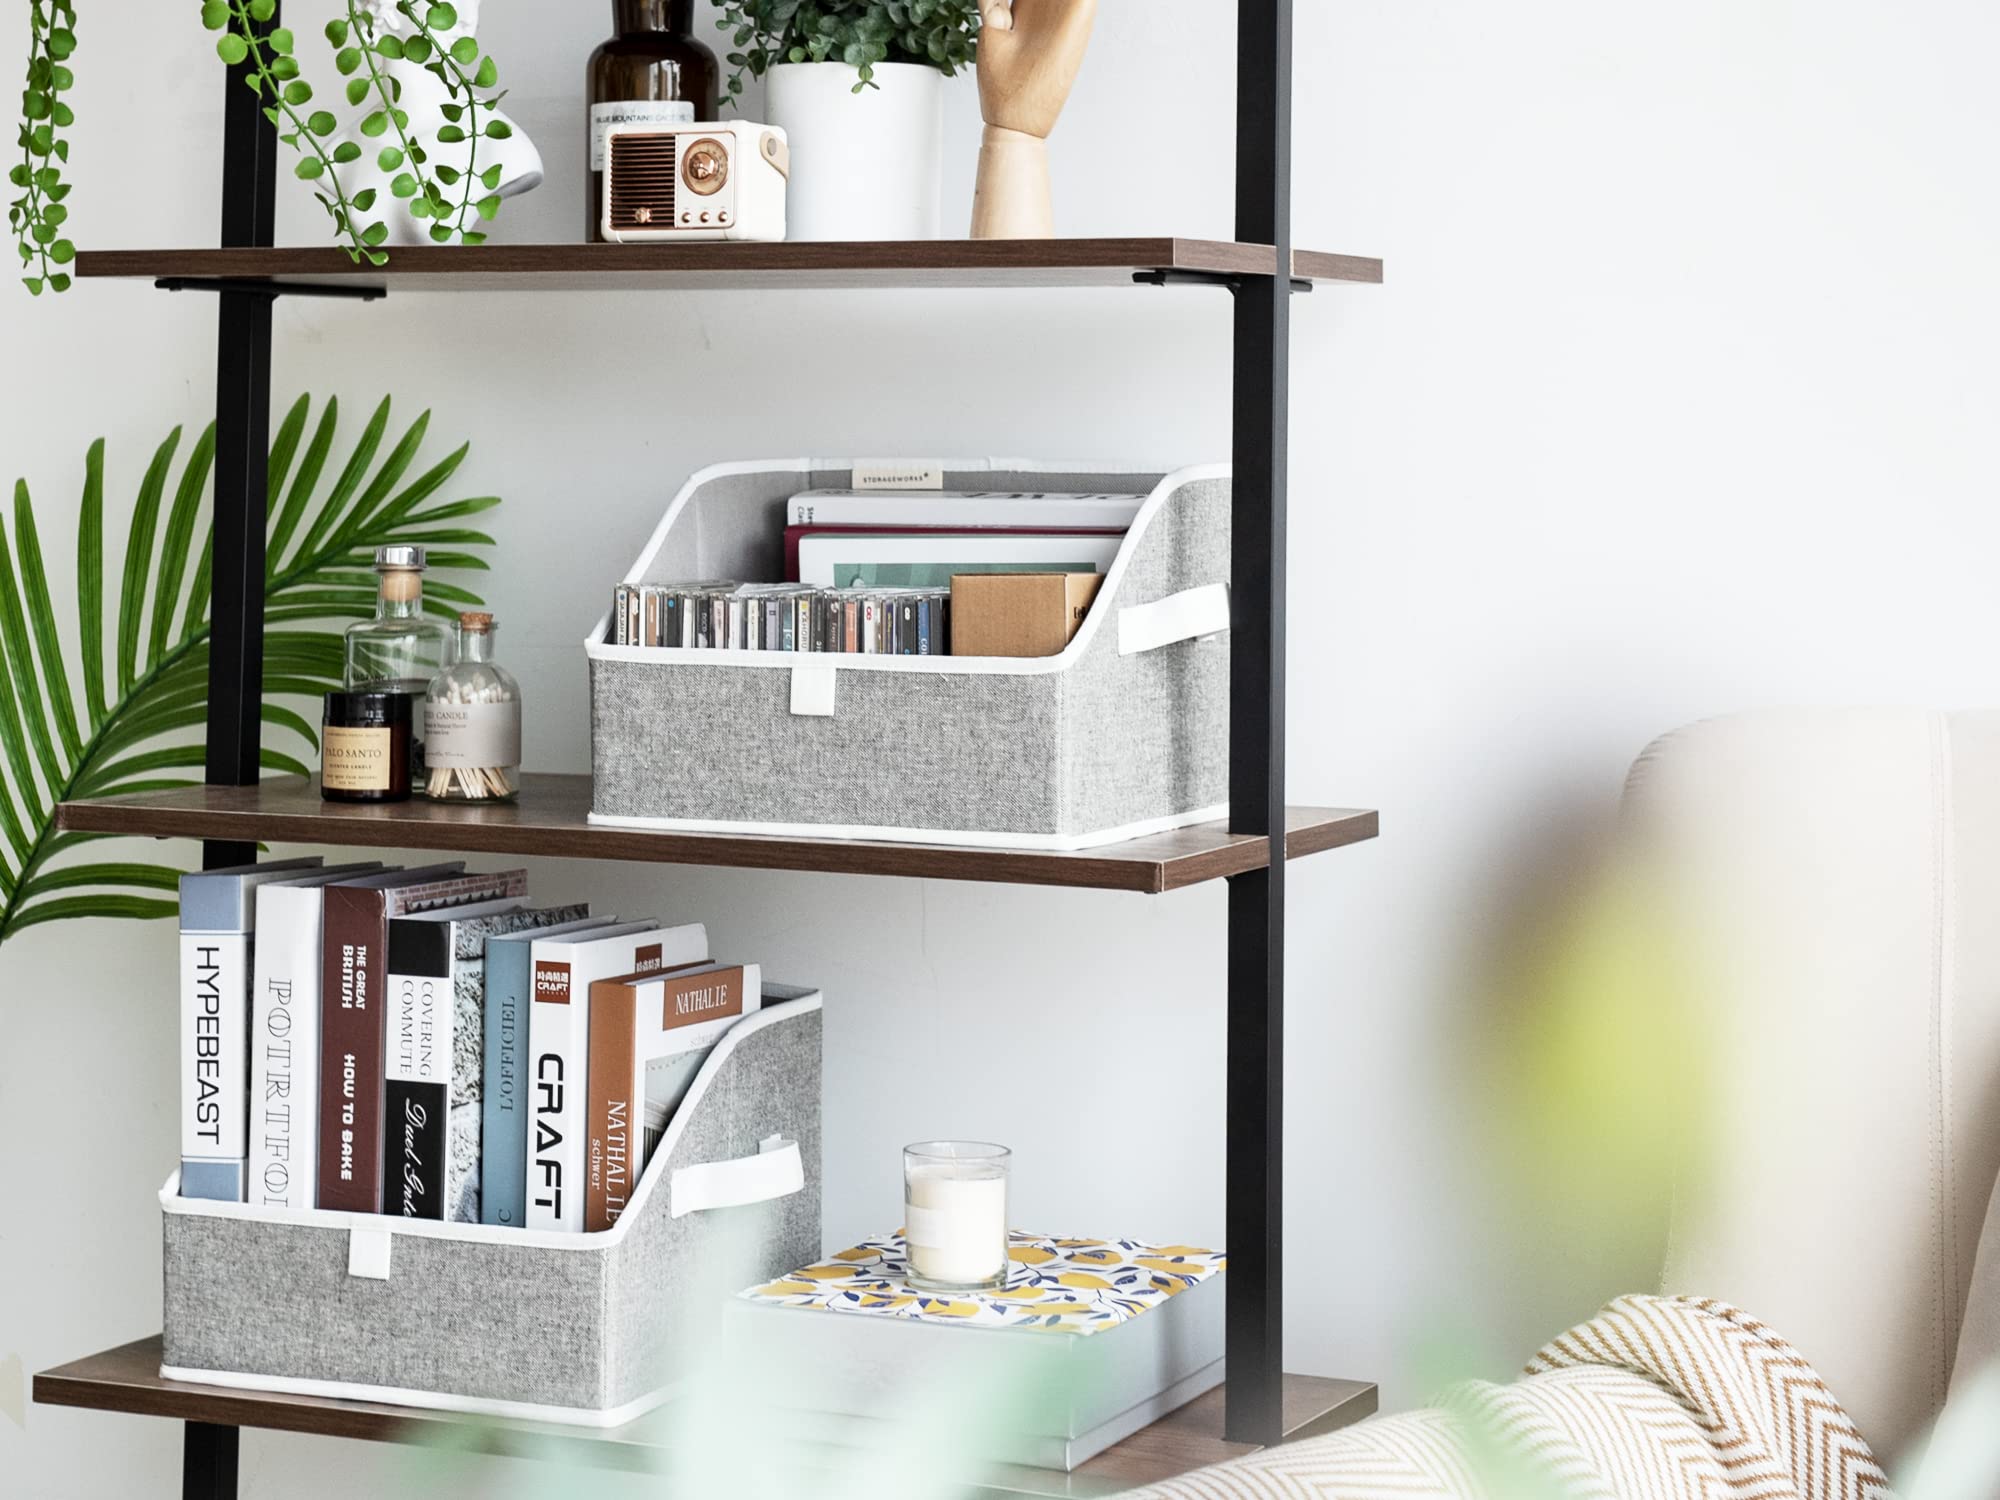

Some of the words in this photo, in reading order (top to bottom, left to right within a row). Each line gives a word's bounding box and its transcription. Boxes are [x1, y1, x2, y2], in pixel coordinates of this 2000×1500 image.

[325, 747, 344, 758] PALO
[345, 748, 382, 759] SANTO
[341, 944, 354, 1009] BRITISH
[357, 944, 367, 967] THE
[356, 968, 366, 1010] GREAT
[536, 981, 569, 992] CRAFT
[675, 984, 729, 1017] NATHALIE
[196, 945, 220, 1145] HYPEBEAST
[400, 980, 413, 1074] COMMUTE
[419, 980, 434, 1077] COVERING
[343, 1054, 355, 1097] HOW
[499, 996, 516, 1112] L'OFFICIEL
[342, 1101, 354, 1126] TO
[535, 1052, 564, 1220] CRAFT
[340, 1129, 354, 1181] BAKE
[591, 1138, 604, 1191] schwer
[604, 1099, 627, 1223] NATHALIE
